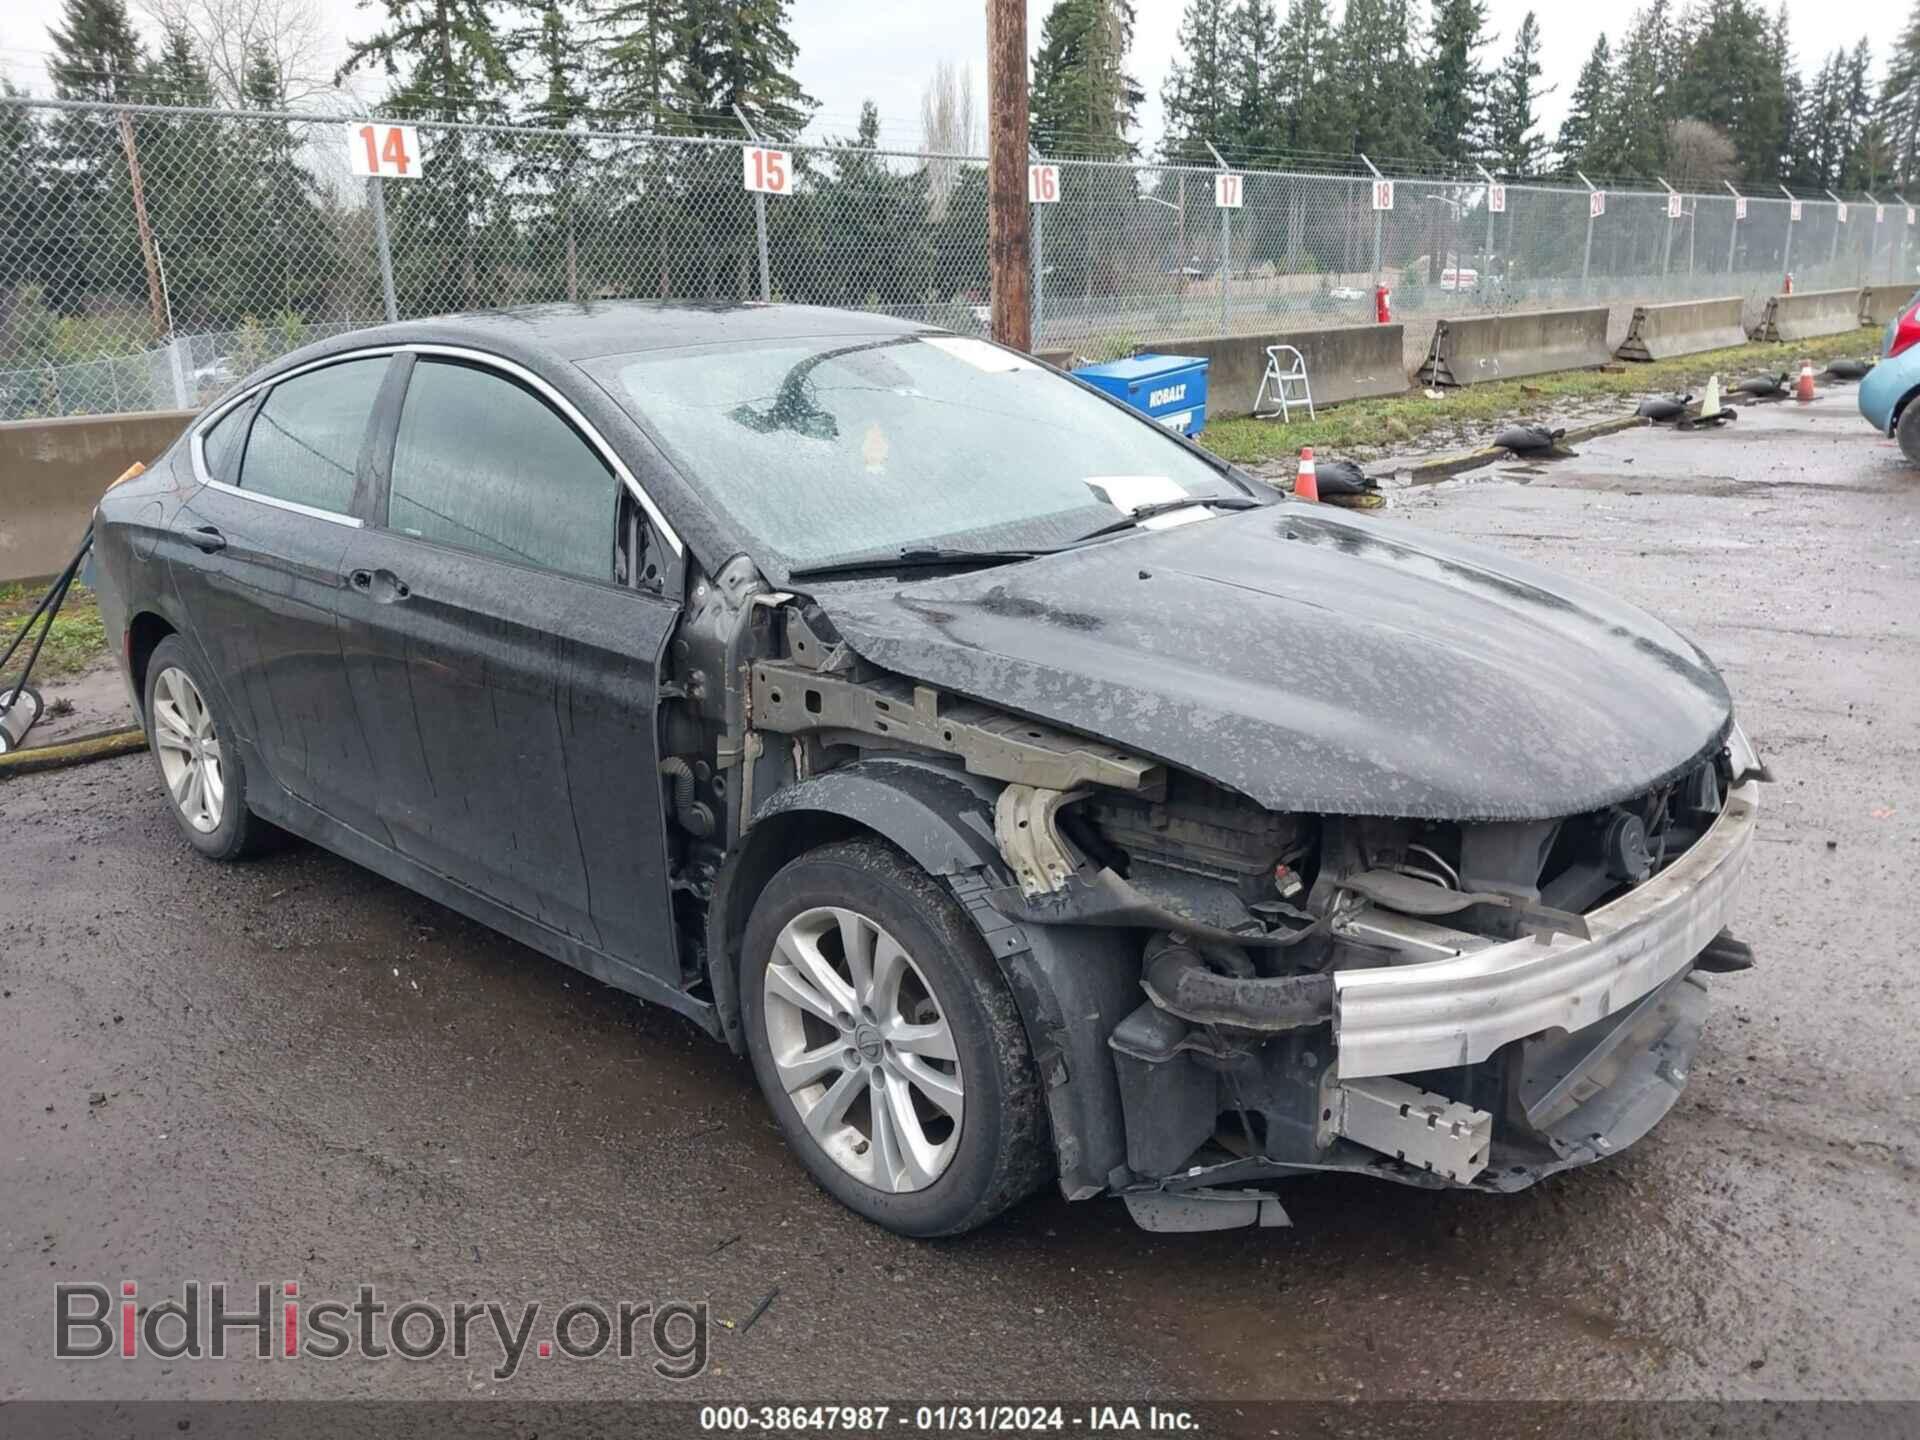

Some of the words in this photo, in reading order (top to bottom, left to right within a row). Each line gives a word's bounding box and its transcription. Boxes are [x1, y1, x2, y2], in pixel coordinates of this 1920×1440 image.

[360, 127, 410, 174] 14
[752, 151, 784, 190] 15
[1036, 169, 1055, 199] 16
[1222, 178, 1236, 205] 17
[1376, 184, 1390, 207] 18
[1490, 188, 1503, 209] 19
[1149, 384, 1187, 408] KOBALT
